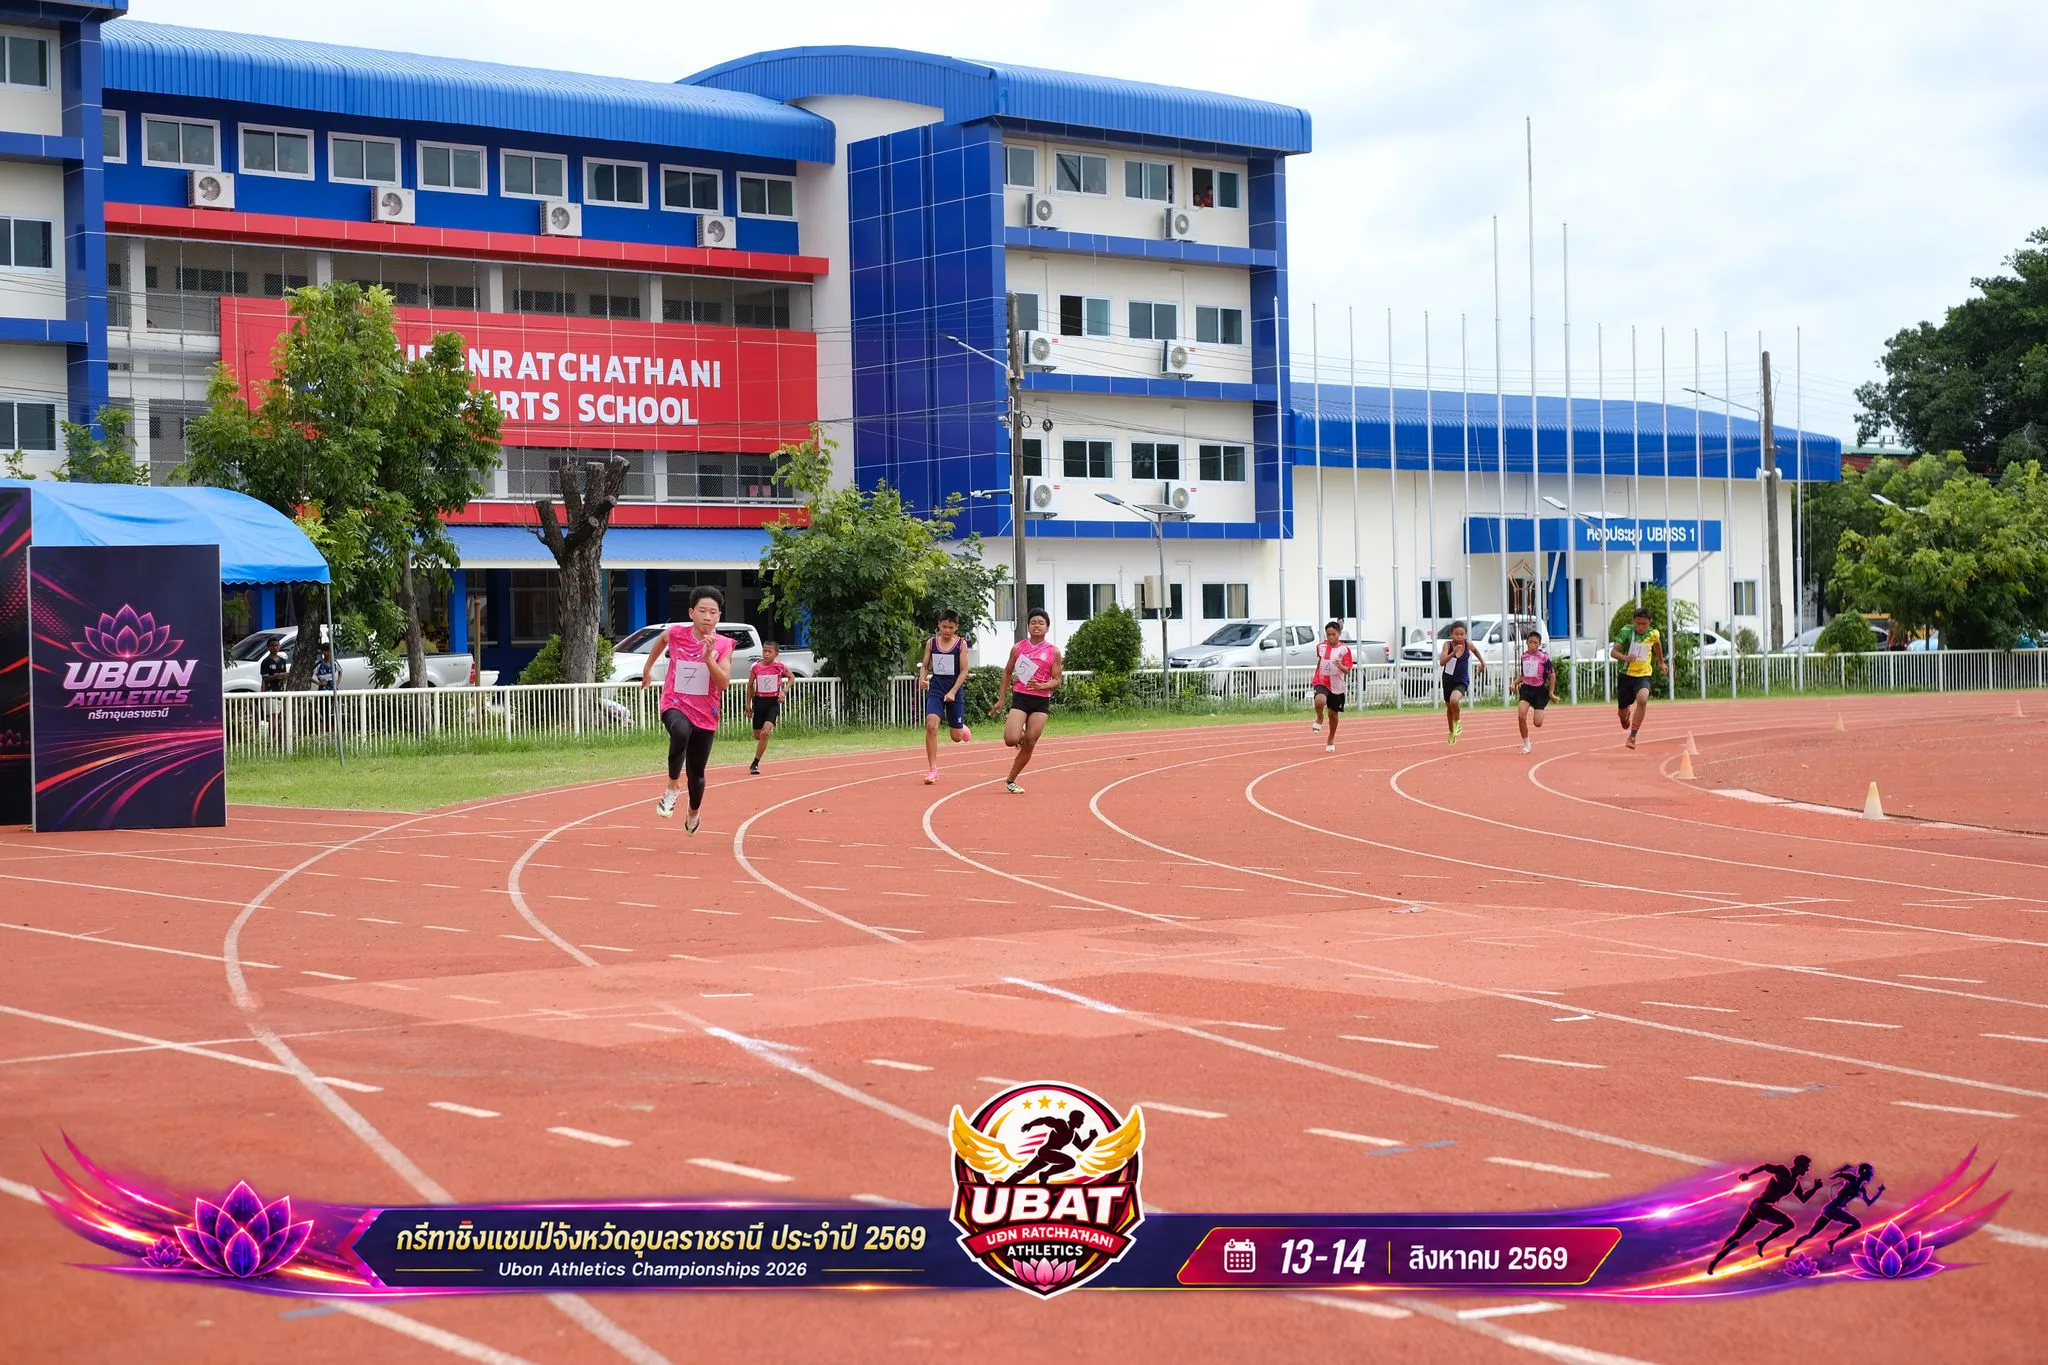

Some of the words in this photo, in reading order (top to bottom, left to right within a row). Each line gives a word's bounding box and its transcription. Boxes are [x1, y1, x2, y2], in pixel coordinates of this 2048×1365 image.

[578, 393, 699, 426] SCHOOL
[1689, 527, 1695, 542] 1
[937, 656, 945, 671] 6
[1018, 660, 1030, 675] 5
[1325, 662, 1332, 673] 4
[63, 659, 199, 690] UBON
[682, 667, 698, 688] 7
[64, 689, 194, 707] ATHLETICS
